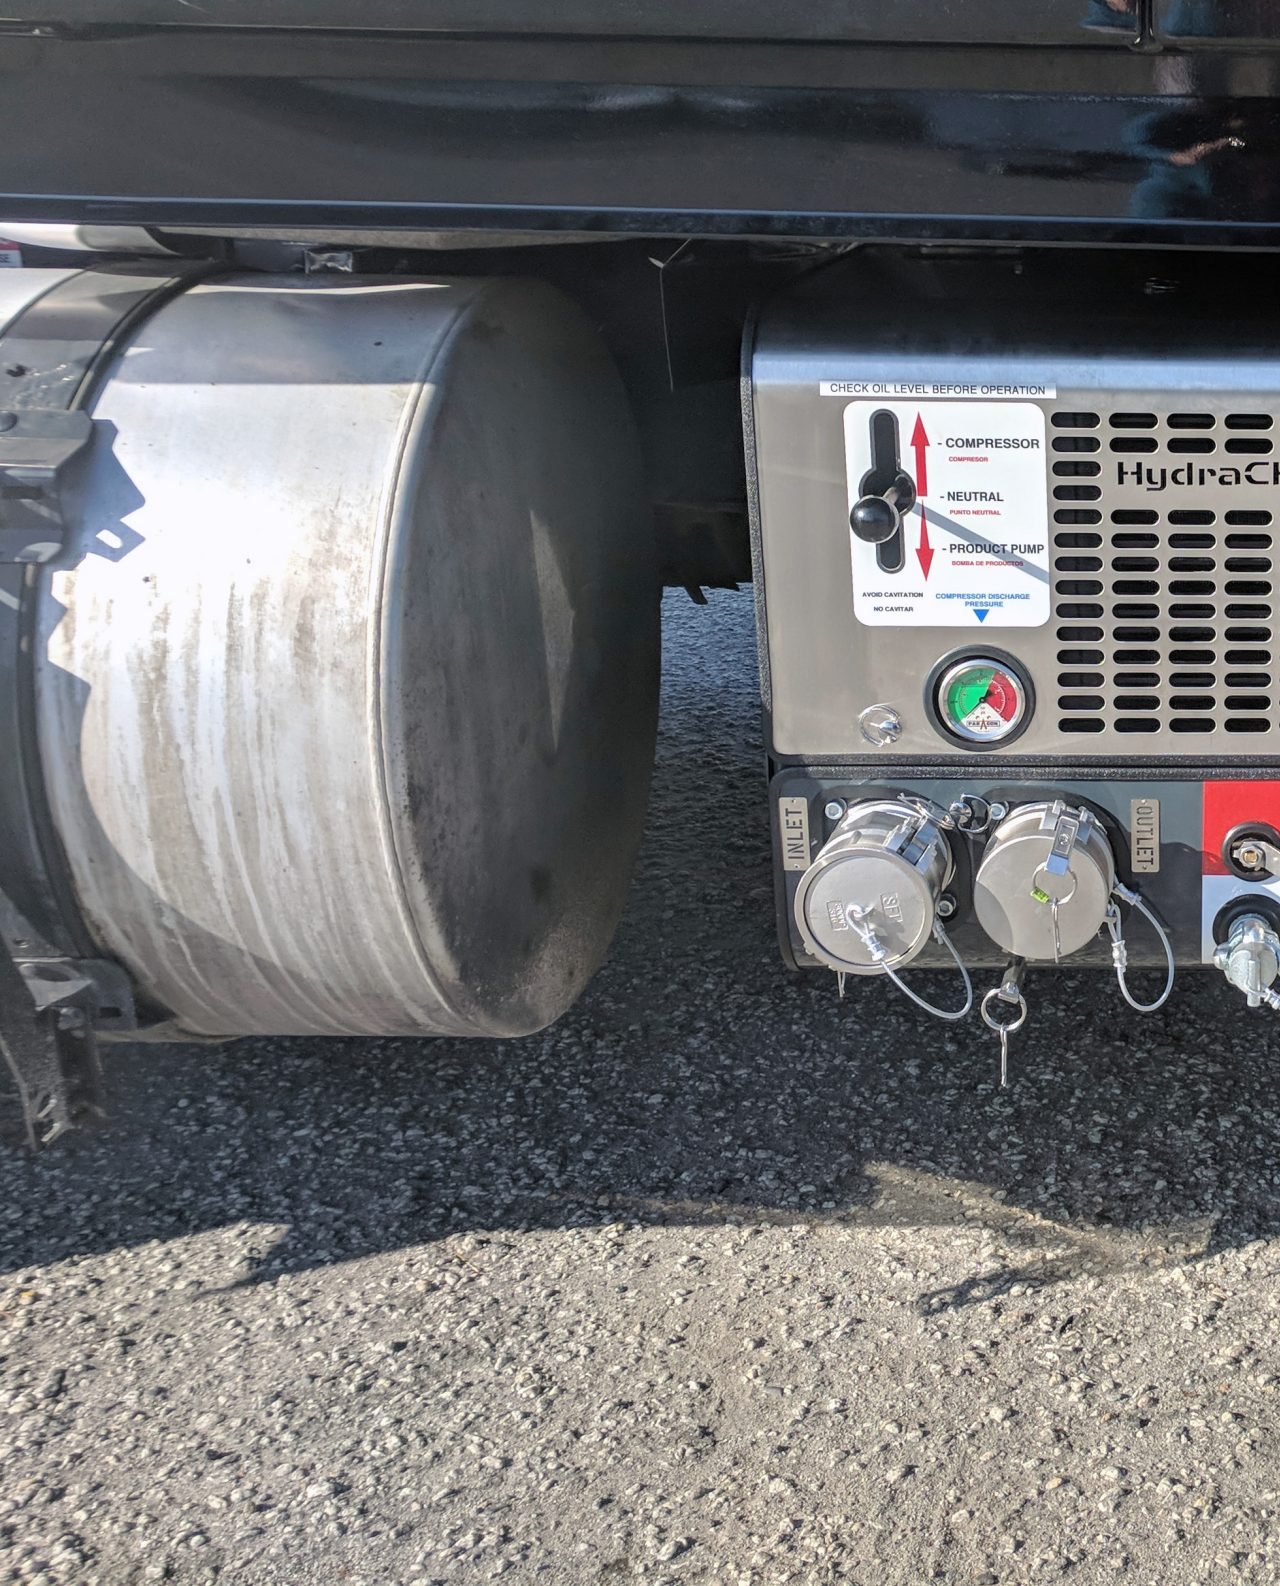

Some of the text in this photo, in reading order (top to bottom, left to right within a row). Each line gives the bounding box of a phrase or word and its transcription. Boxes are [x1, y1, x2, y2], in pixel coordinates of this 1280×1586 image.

[830, 384, 1046, 395] CHECK OIL LEVEL BEFORE OPERATION
[945, 438, 1040, 449] COMPRESSOR
[947, 491, 1004, 502] NEUTRAL
[949, 543, 1008, 554] PRODUCT
[1011, 544, 1045, 554] PUMP
[785, 807, 805, 860] INLET
[1136, 806, 1154, 865] OUTLET
